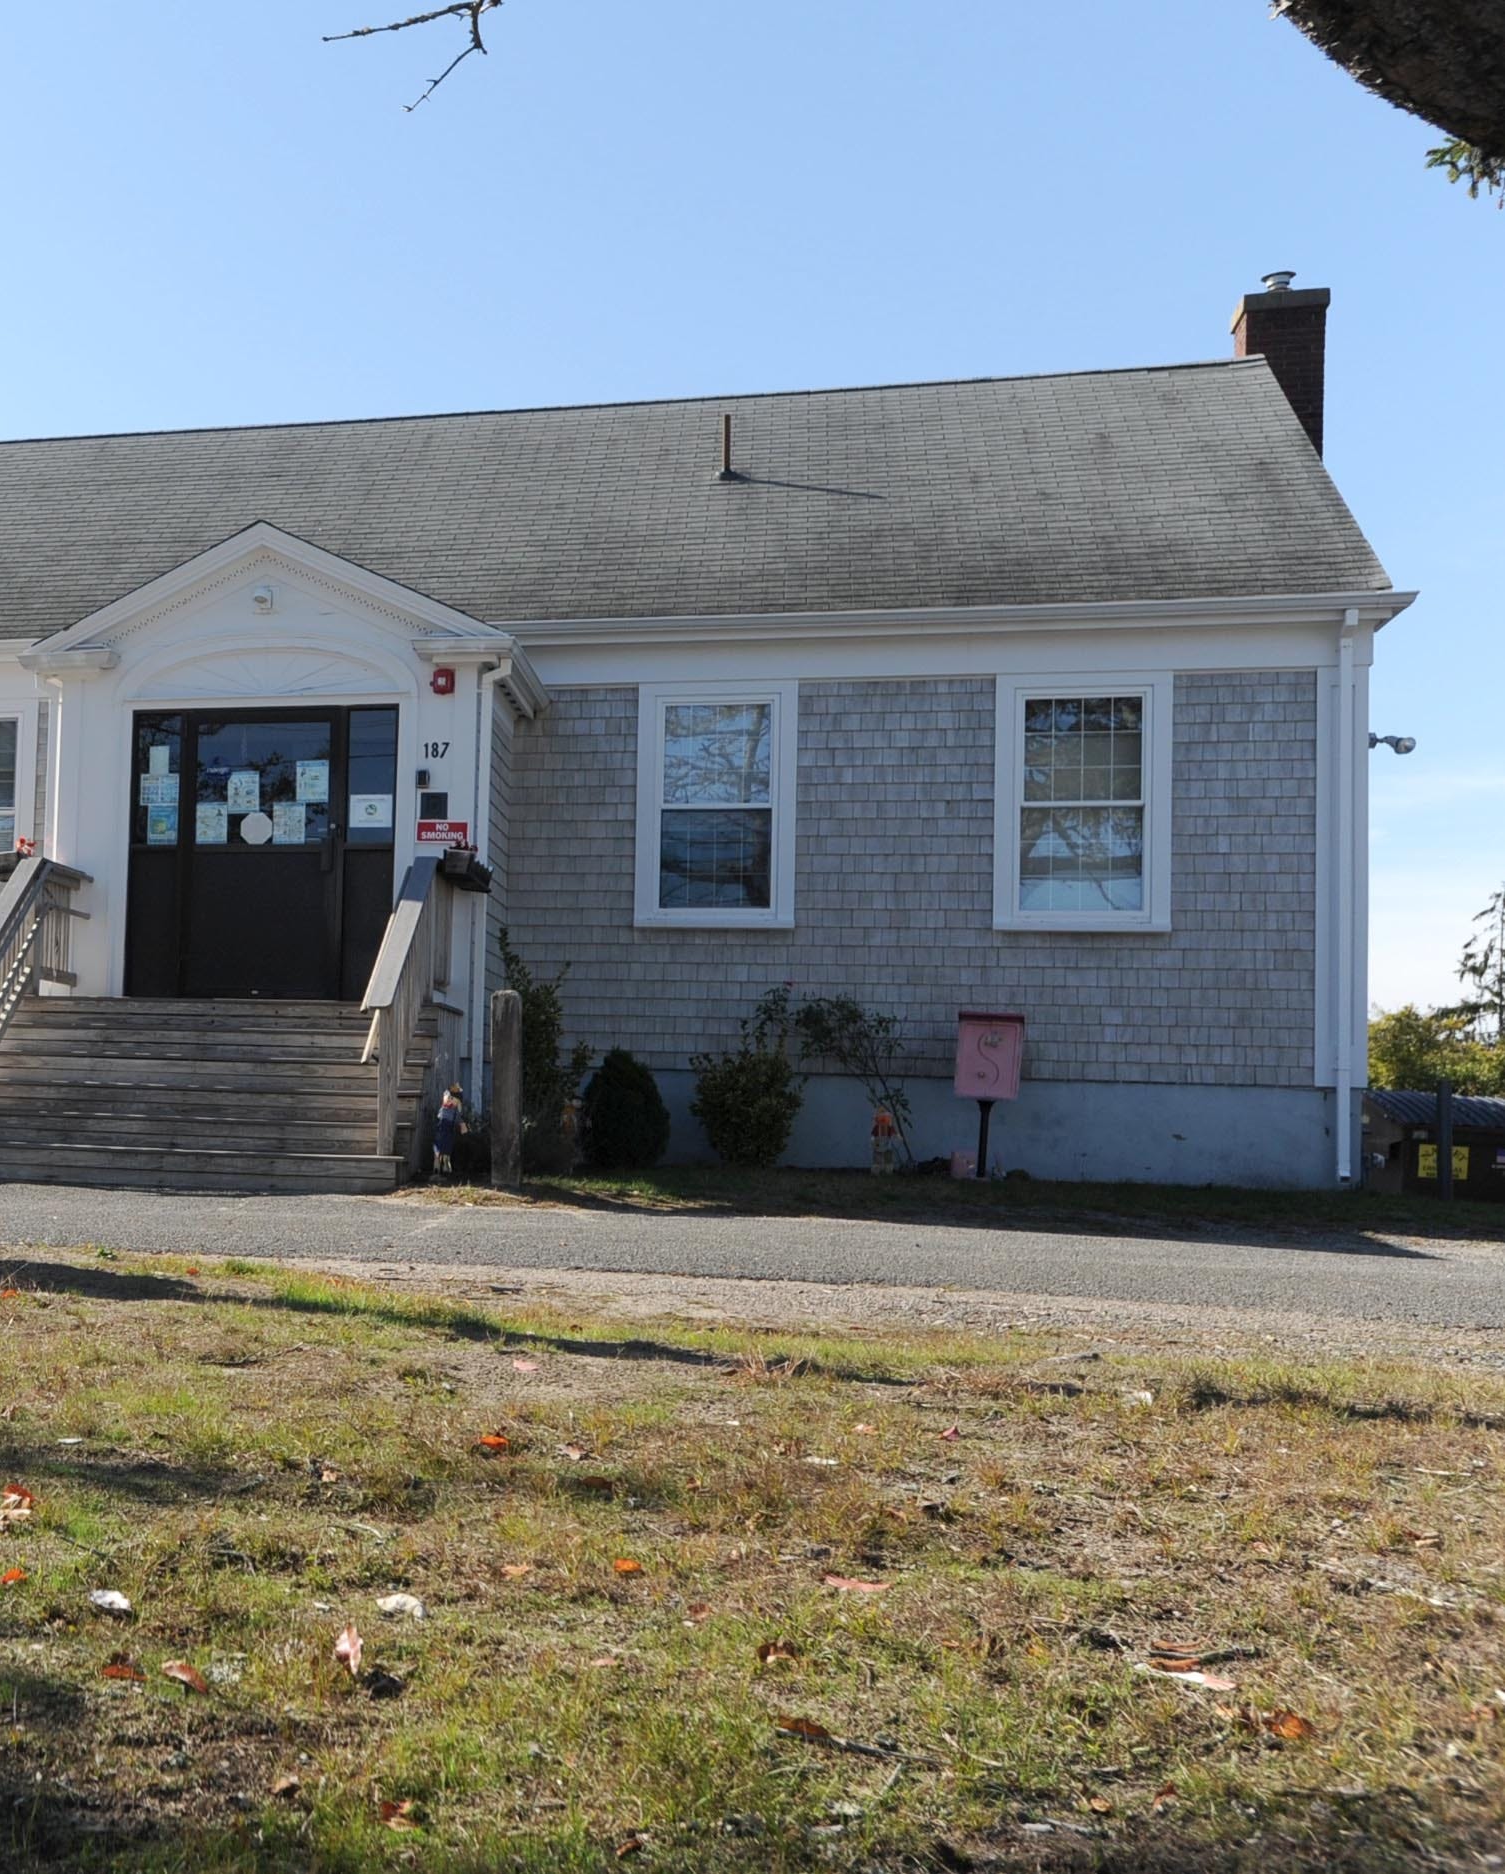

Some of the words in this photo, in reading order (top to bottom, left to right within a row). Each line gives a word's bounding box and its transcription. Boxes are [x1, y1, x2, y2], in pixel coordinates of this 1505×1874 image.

[423, 742, 450, 759] 187
[435, 823, 449, 831] NO
[421, 831, 464, 840] SMOKING
